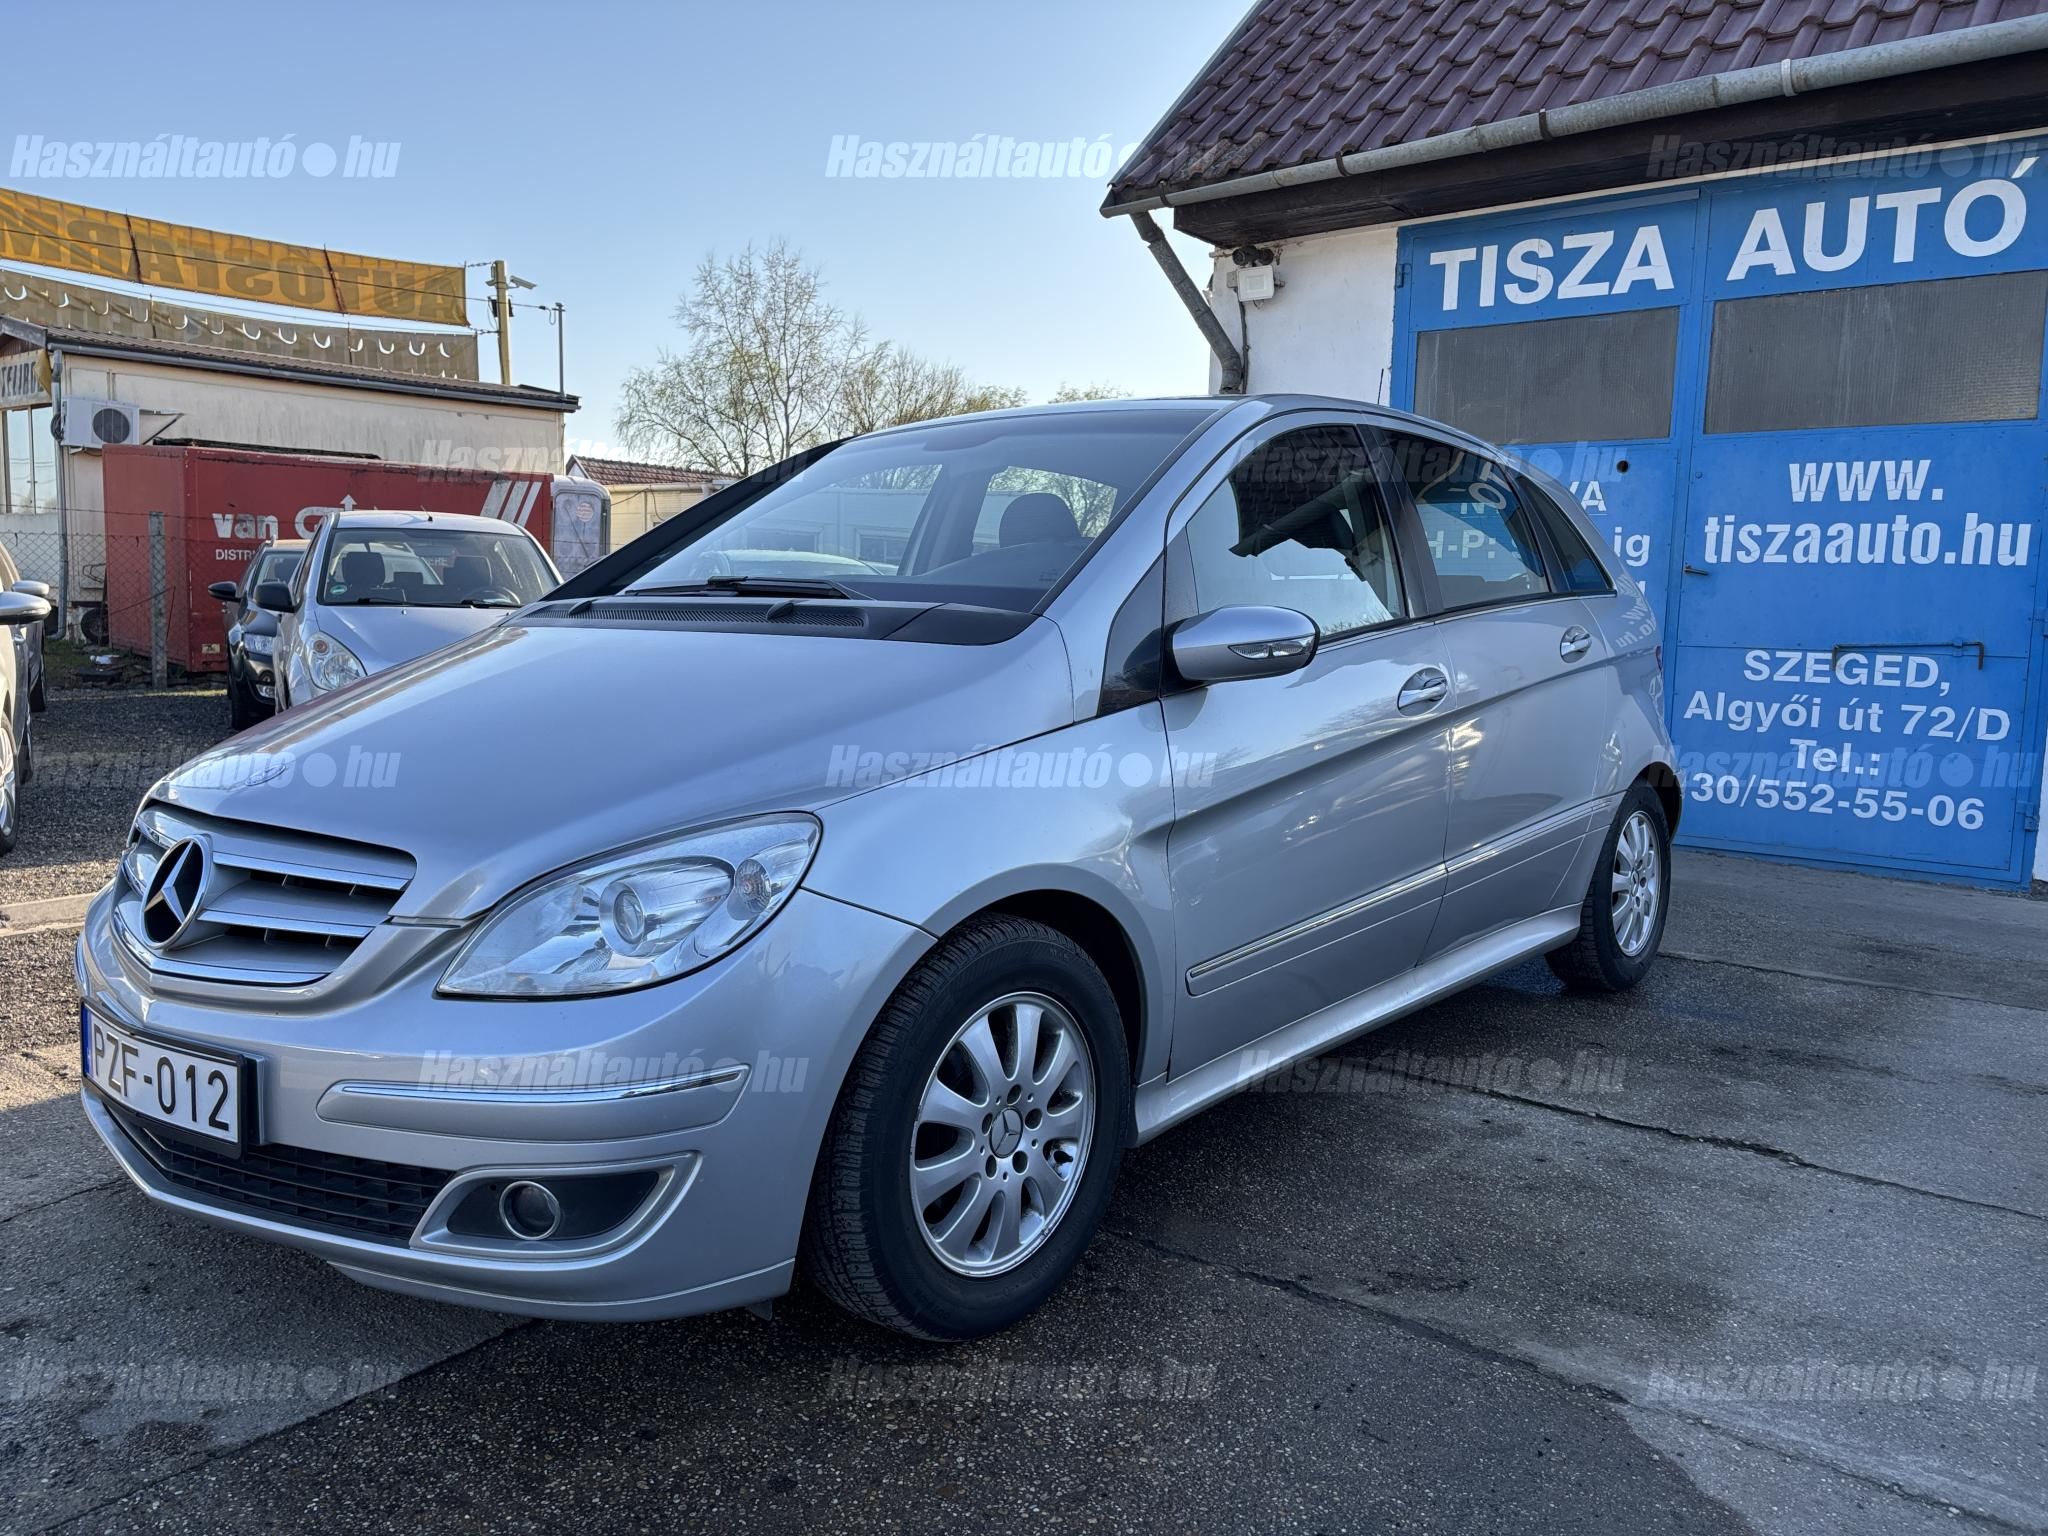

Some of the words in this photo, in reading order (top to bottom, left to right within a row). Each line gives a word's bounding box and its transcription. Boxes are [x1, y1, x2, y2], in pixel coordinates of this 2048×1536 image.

[1429, 225, 1674, 311] TISZA
[1727, 156, 2040, 282] AUTÓ
[1789, 459, 1944, 502] www.
[211, 512, 279, 540] van
[1704, 512, 2032, 566] tiszaauto.hu
[1743, 649, 1951, 697] SZEGED,
[1683, 690, 1822, 733] Algyői
[1837, 698, 1882, 733] út
[1900, 703, 2011, 742] 72/D
[1789, 738, 1880, 776] Tel.:
[1690, 772, 1985, 830] 30/552-55-06
[93, 1023, 230, 1132] PZF-012
